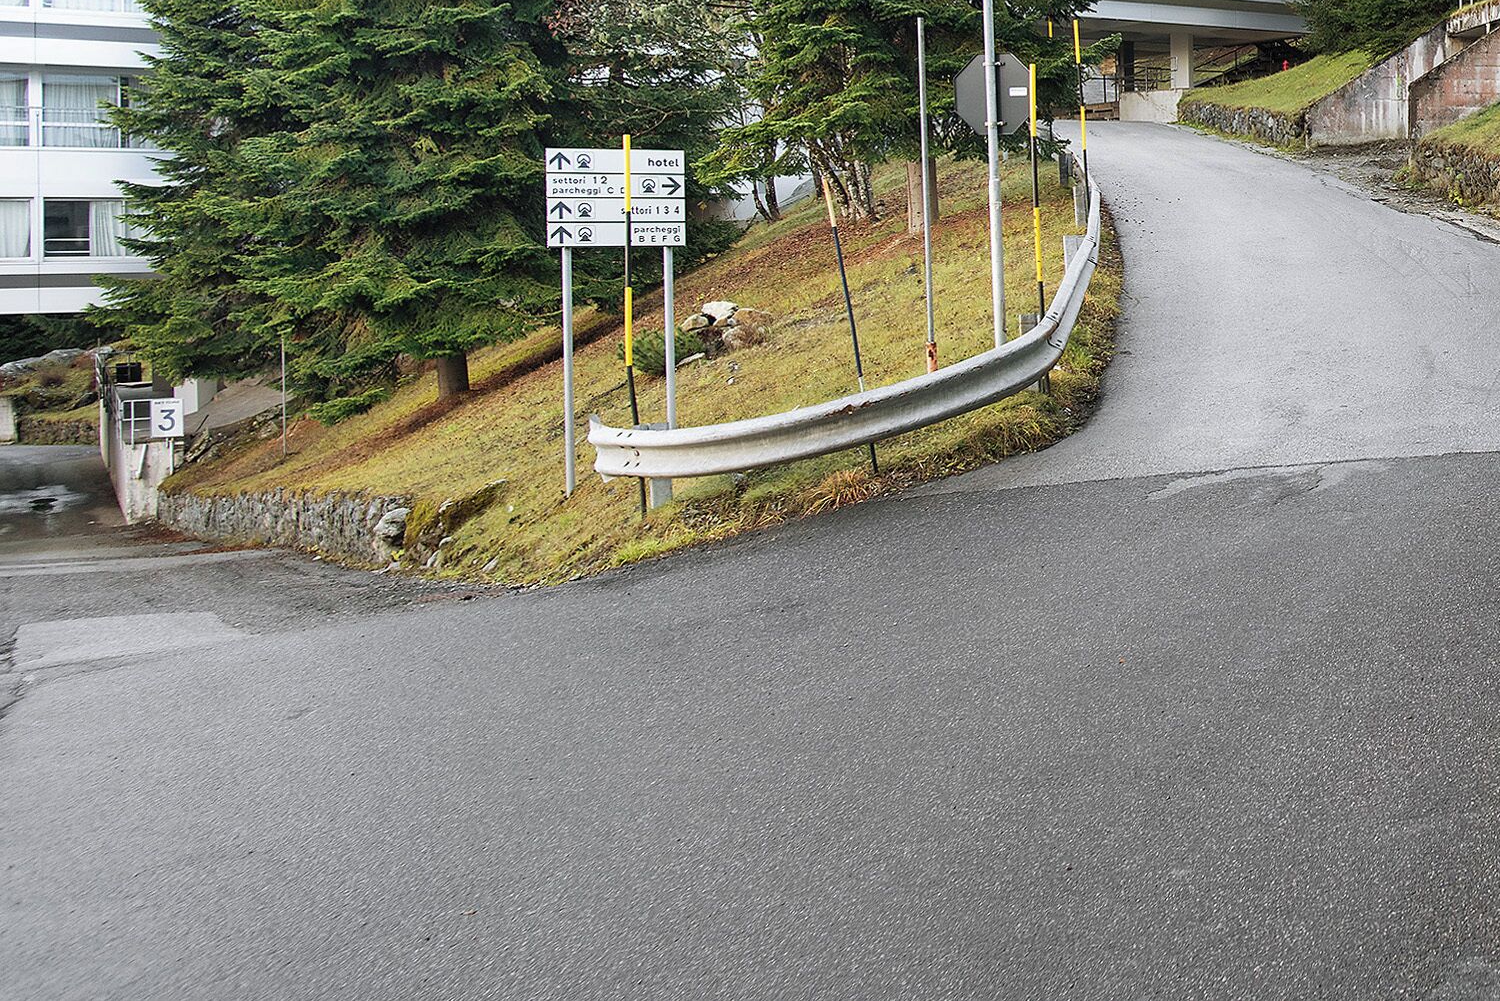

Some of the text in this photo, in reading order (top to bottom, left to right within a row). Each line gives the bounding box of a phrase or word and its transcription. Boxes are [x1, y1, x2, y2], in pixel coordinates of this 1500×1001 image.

[648, 158, 679, 167] hotel
[552, 176, 586, 184] settori
[552, 187, 601, 195] parcheggi
[607, 186, 614, 194] C
[621, 206, 680, 215] sttori 1 3 4
[634, 226, 681, 234] parcheggi
[158, 409, 175, 431] 3
